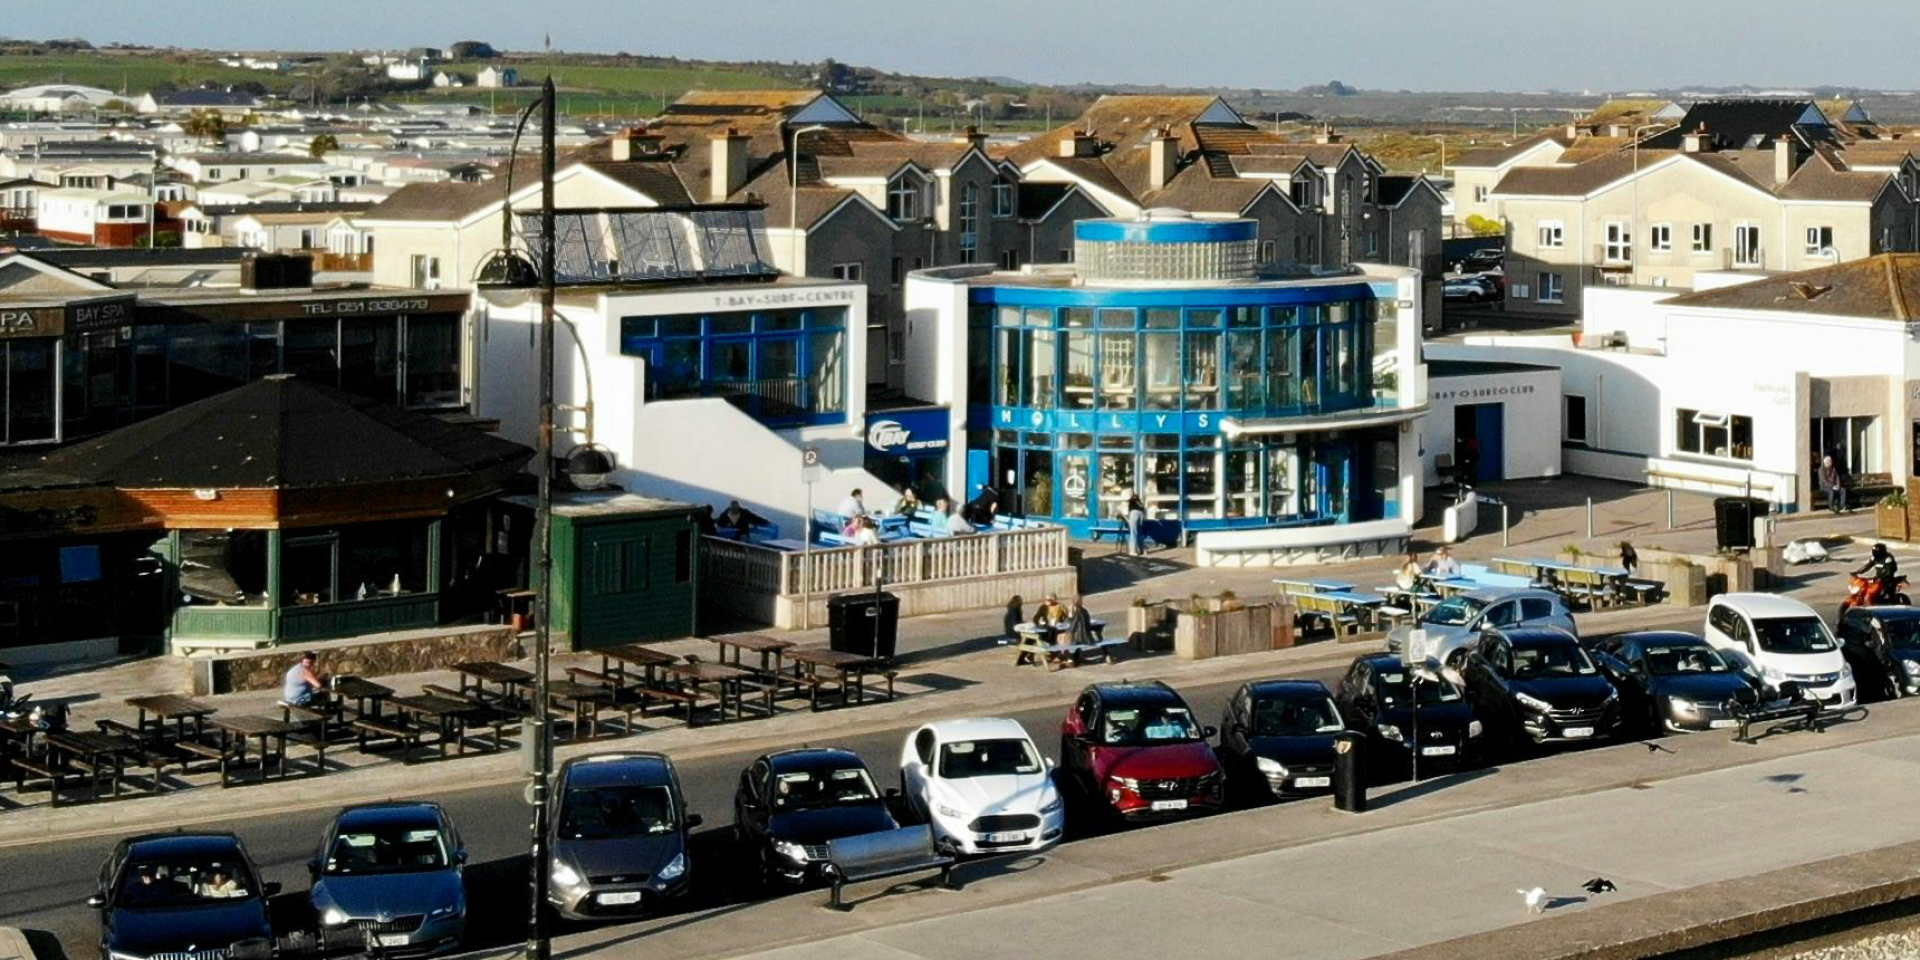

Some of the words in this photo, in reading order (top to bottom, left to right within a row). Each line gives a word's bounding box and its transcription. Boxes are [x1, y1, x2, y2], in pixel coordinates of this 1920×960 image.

[805, 290, 855, 302] CENTRE
[337, 301, 364, 313] 051
[76, 307, 99, 323] BAY
